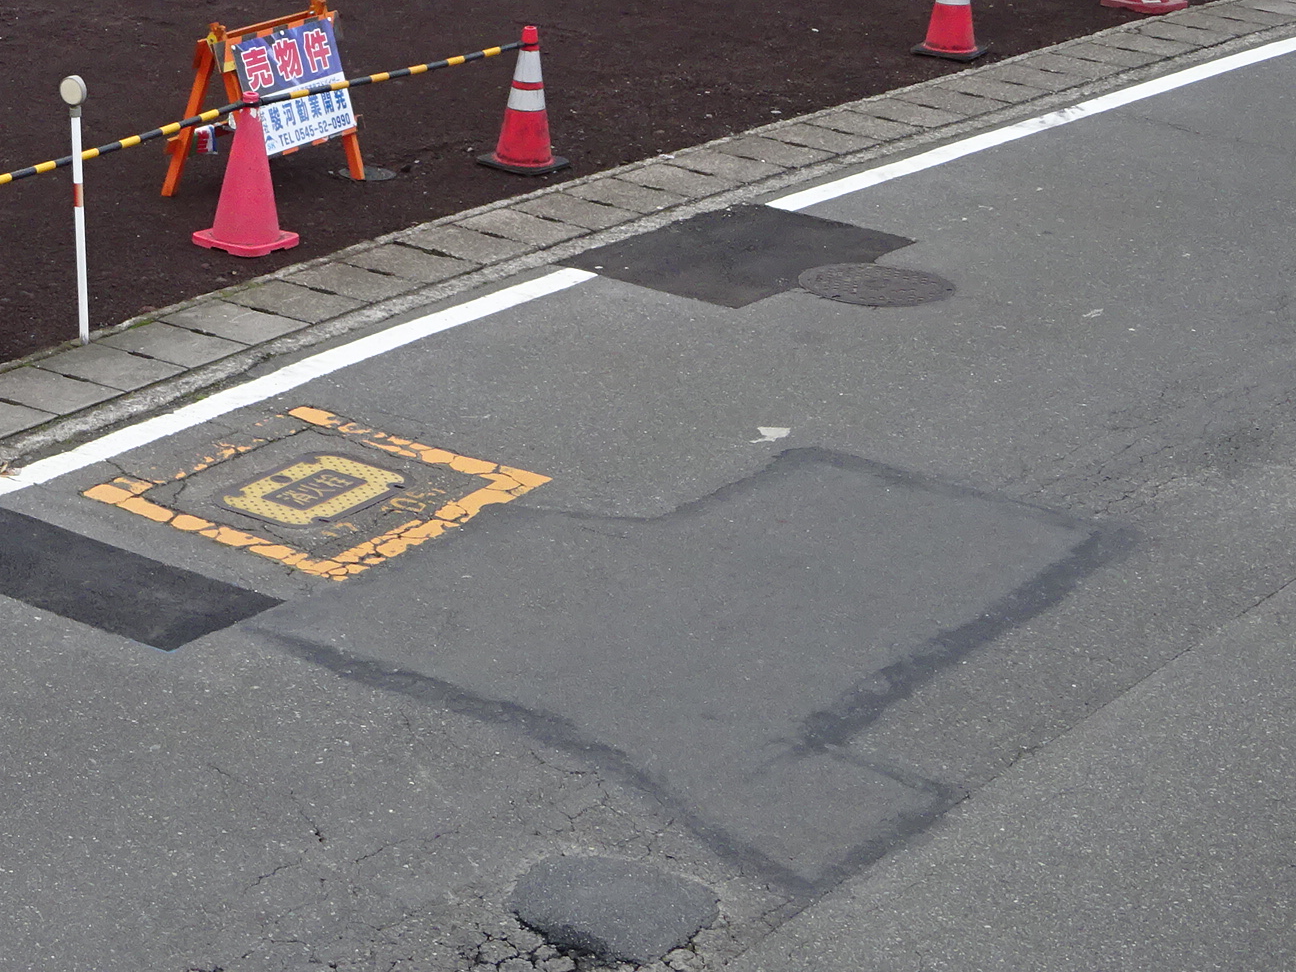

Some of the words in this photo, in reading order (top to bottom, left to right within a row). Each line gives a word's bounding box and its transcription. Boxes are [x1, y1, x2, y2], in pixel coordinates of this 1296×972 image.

[241, 28, 332, 91] 売物件
[278, 131, 295, 146] TEL
[295, 112, 351, 142] 0545-52-0990
[275, 473, 355, 506] 消火栓
